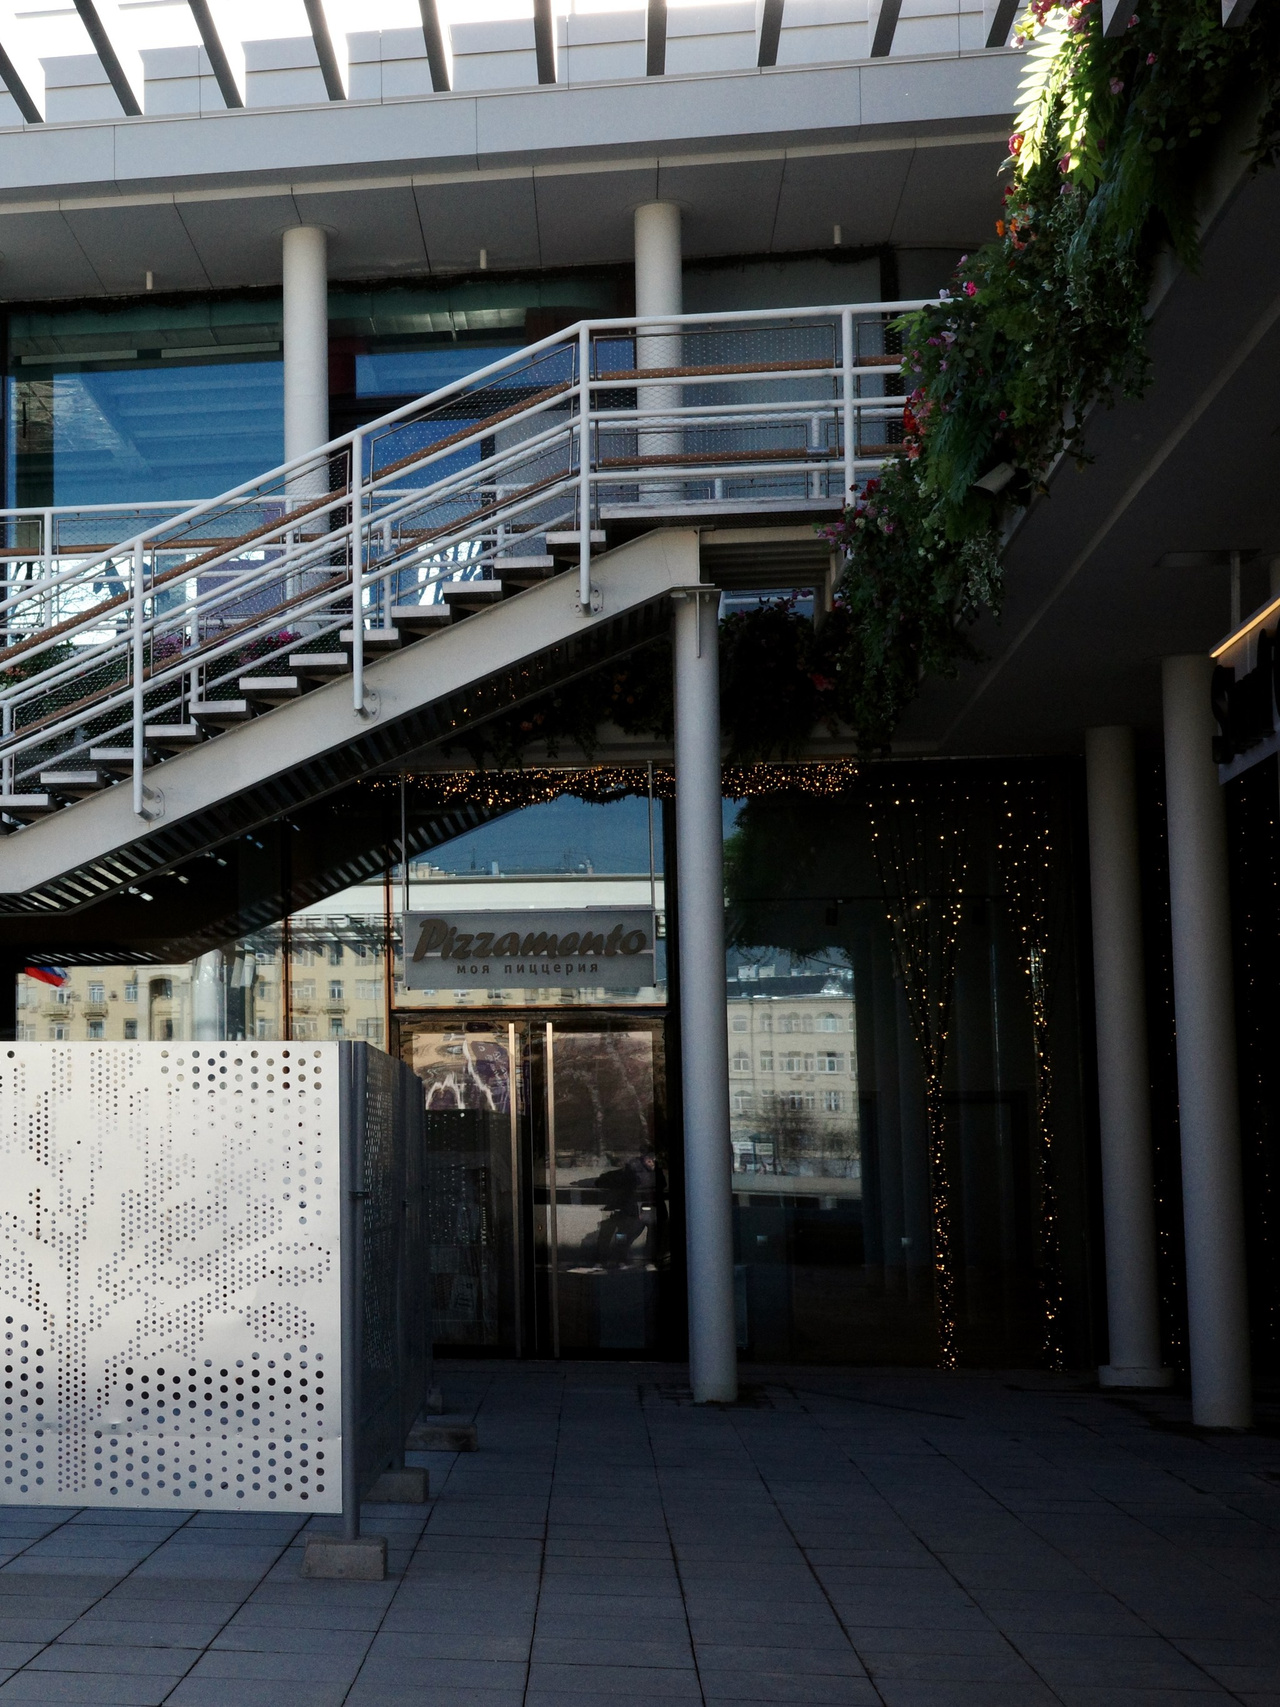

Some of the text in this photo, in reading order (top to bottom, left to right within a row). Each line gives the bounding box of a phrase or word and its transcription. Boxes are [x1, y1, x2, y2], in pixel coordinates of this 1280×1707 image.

[412, 918, 647, 962] Pizzamento
[456, 962, 599, 977] моя пиццерия
